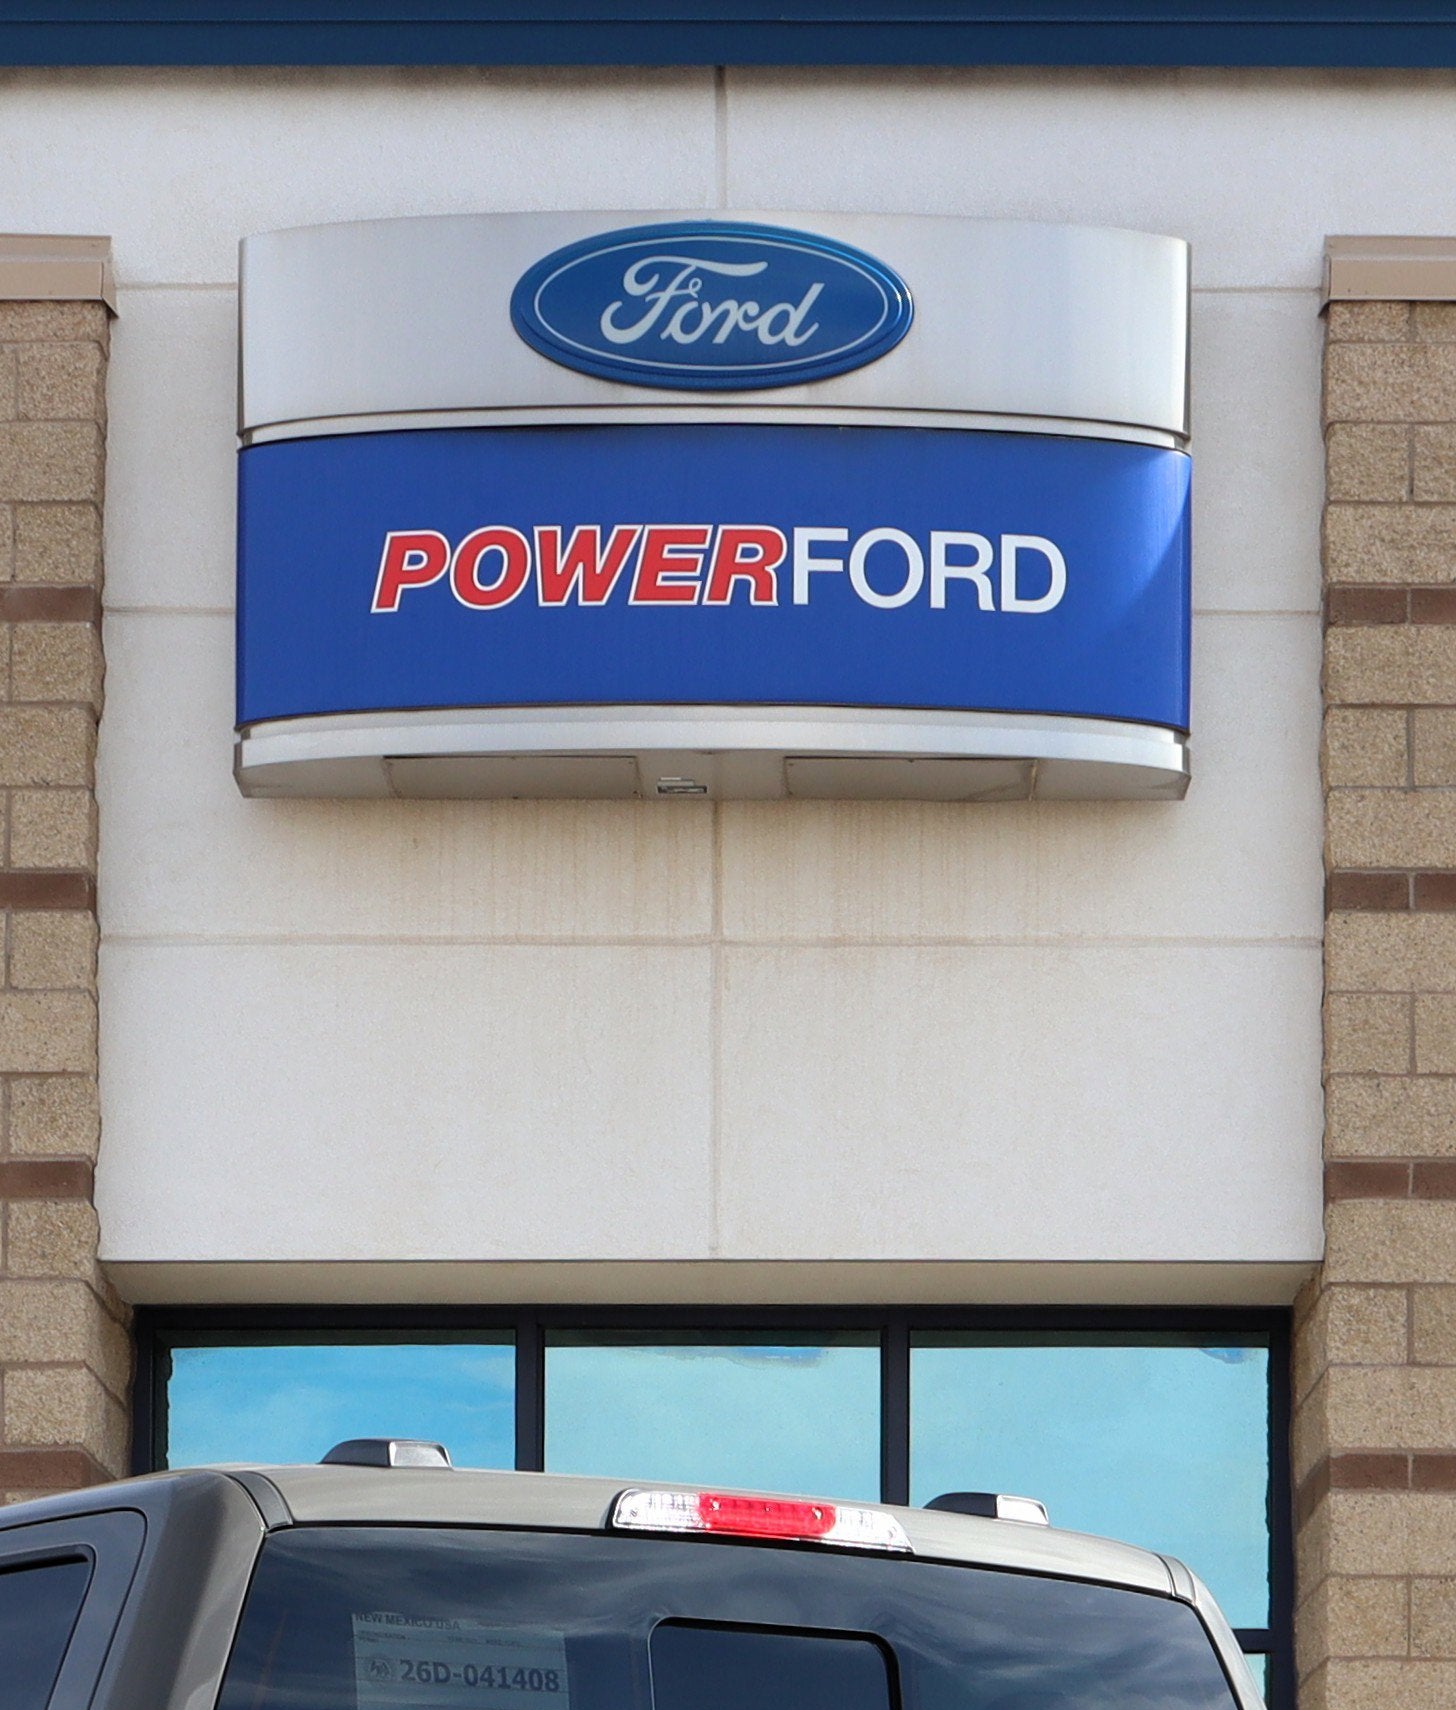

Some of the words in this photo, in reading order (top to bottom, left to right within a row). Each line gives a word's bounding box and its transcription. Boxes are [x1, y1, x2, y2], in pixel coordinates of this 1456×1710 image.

[599, 255, 819, 348] Ford
[370, 524, 1067, 614] POWERFORD
[355, 1612, 383, 1625] NEW
[385, 1614, 433, 1630] MEXICO
[434, 1618, 460, 1632] USA
[400, 1659, 559, 1693] 26D-041408
